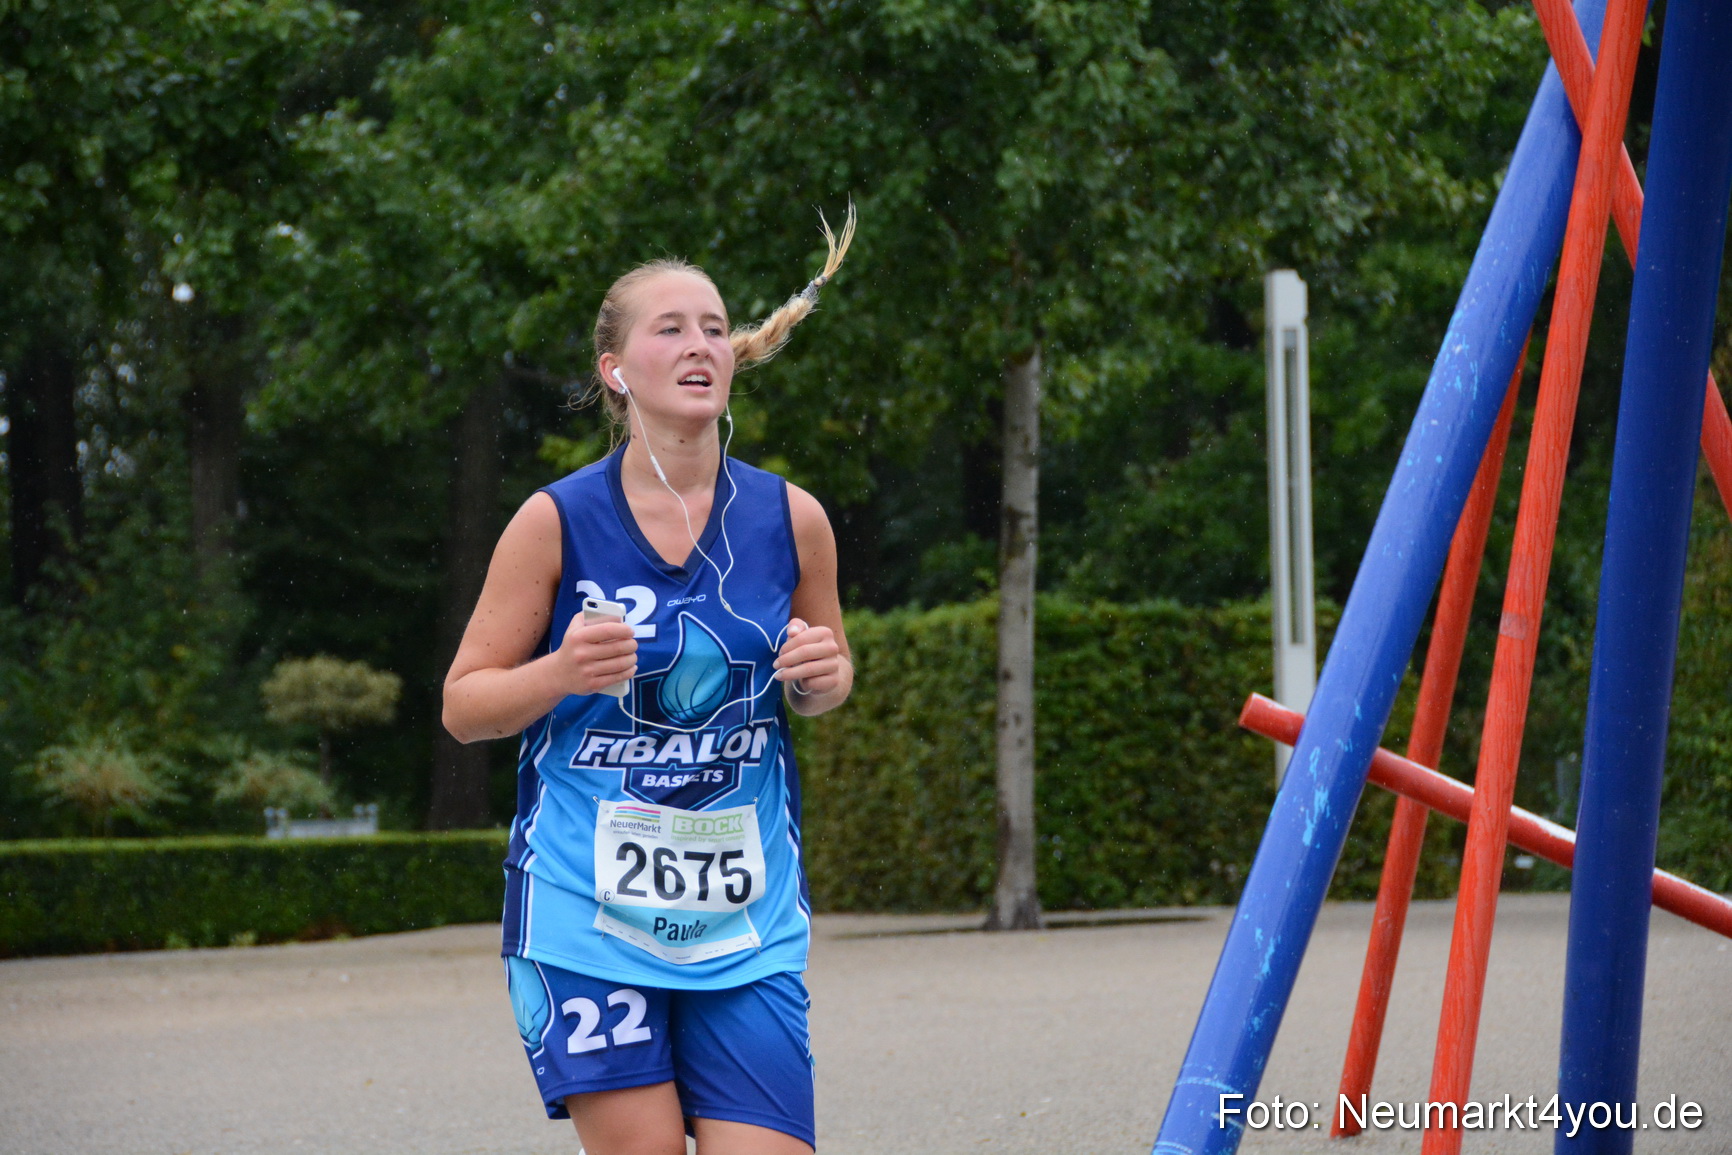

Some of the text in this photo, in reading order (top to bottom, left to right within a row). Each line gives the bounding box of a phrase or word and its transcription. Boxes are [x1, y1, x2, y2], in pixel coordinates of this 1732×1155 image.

[610, 819, 661, 834] NeuerMarkt
[672, 814, 744, 836] BOCK
[616, 841, 752, 904] 2675
[603, 890, 611, 902] C
[653, 917, 707, 942] Paula
[561, 988, 652, 1054] 22
